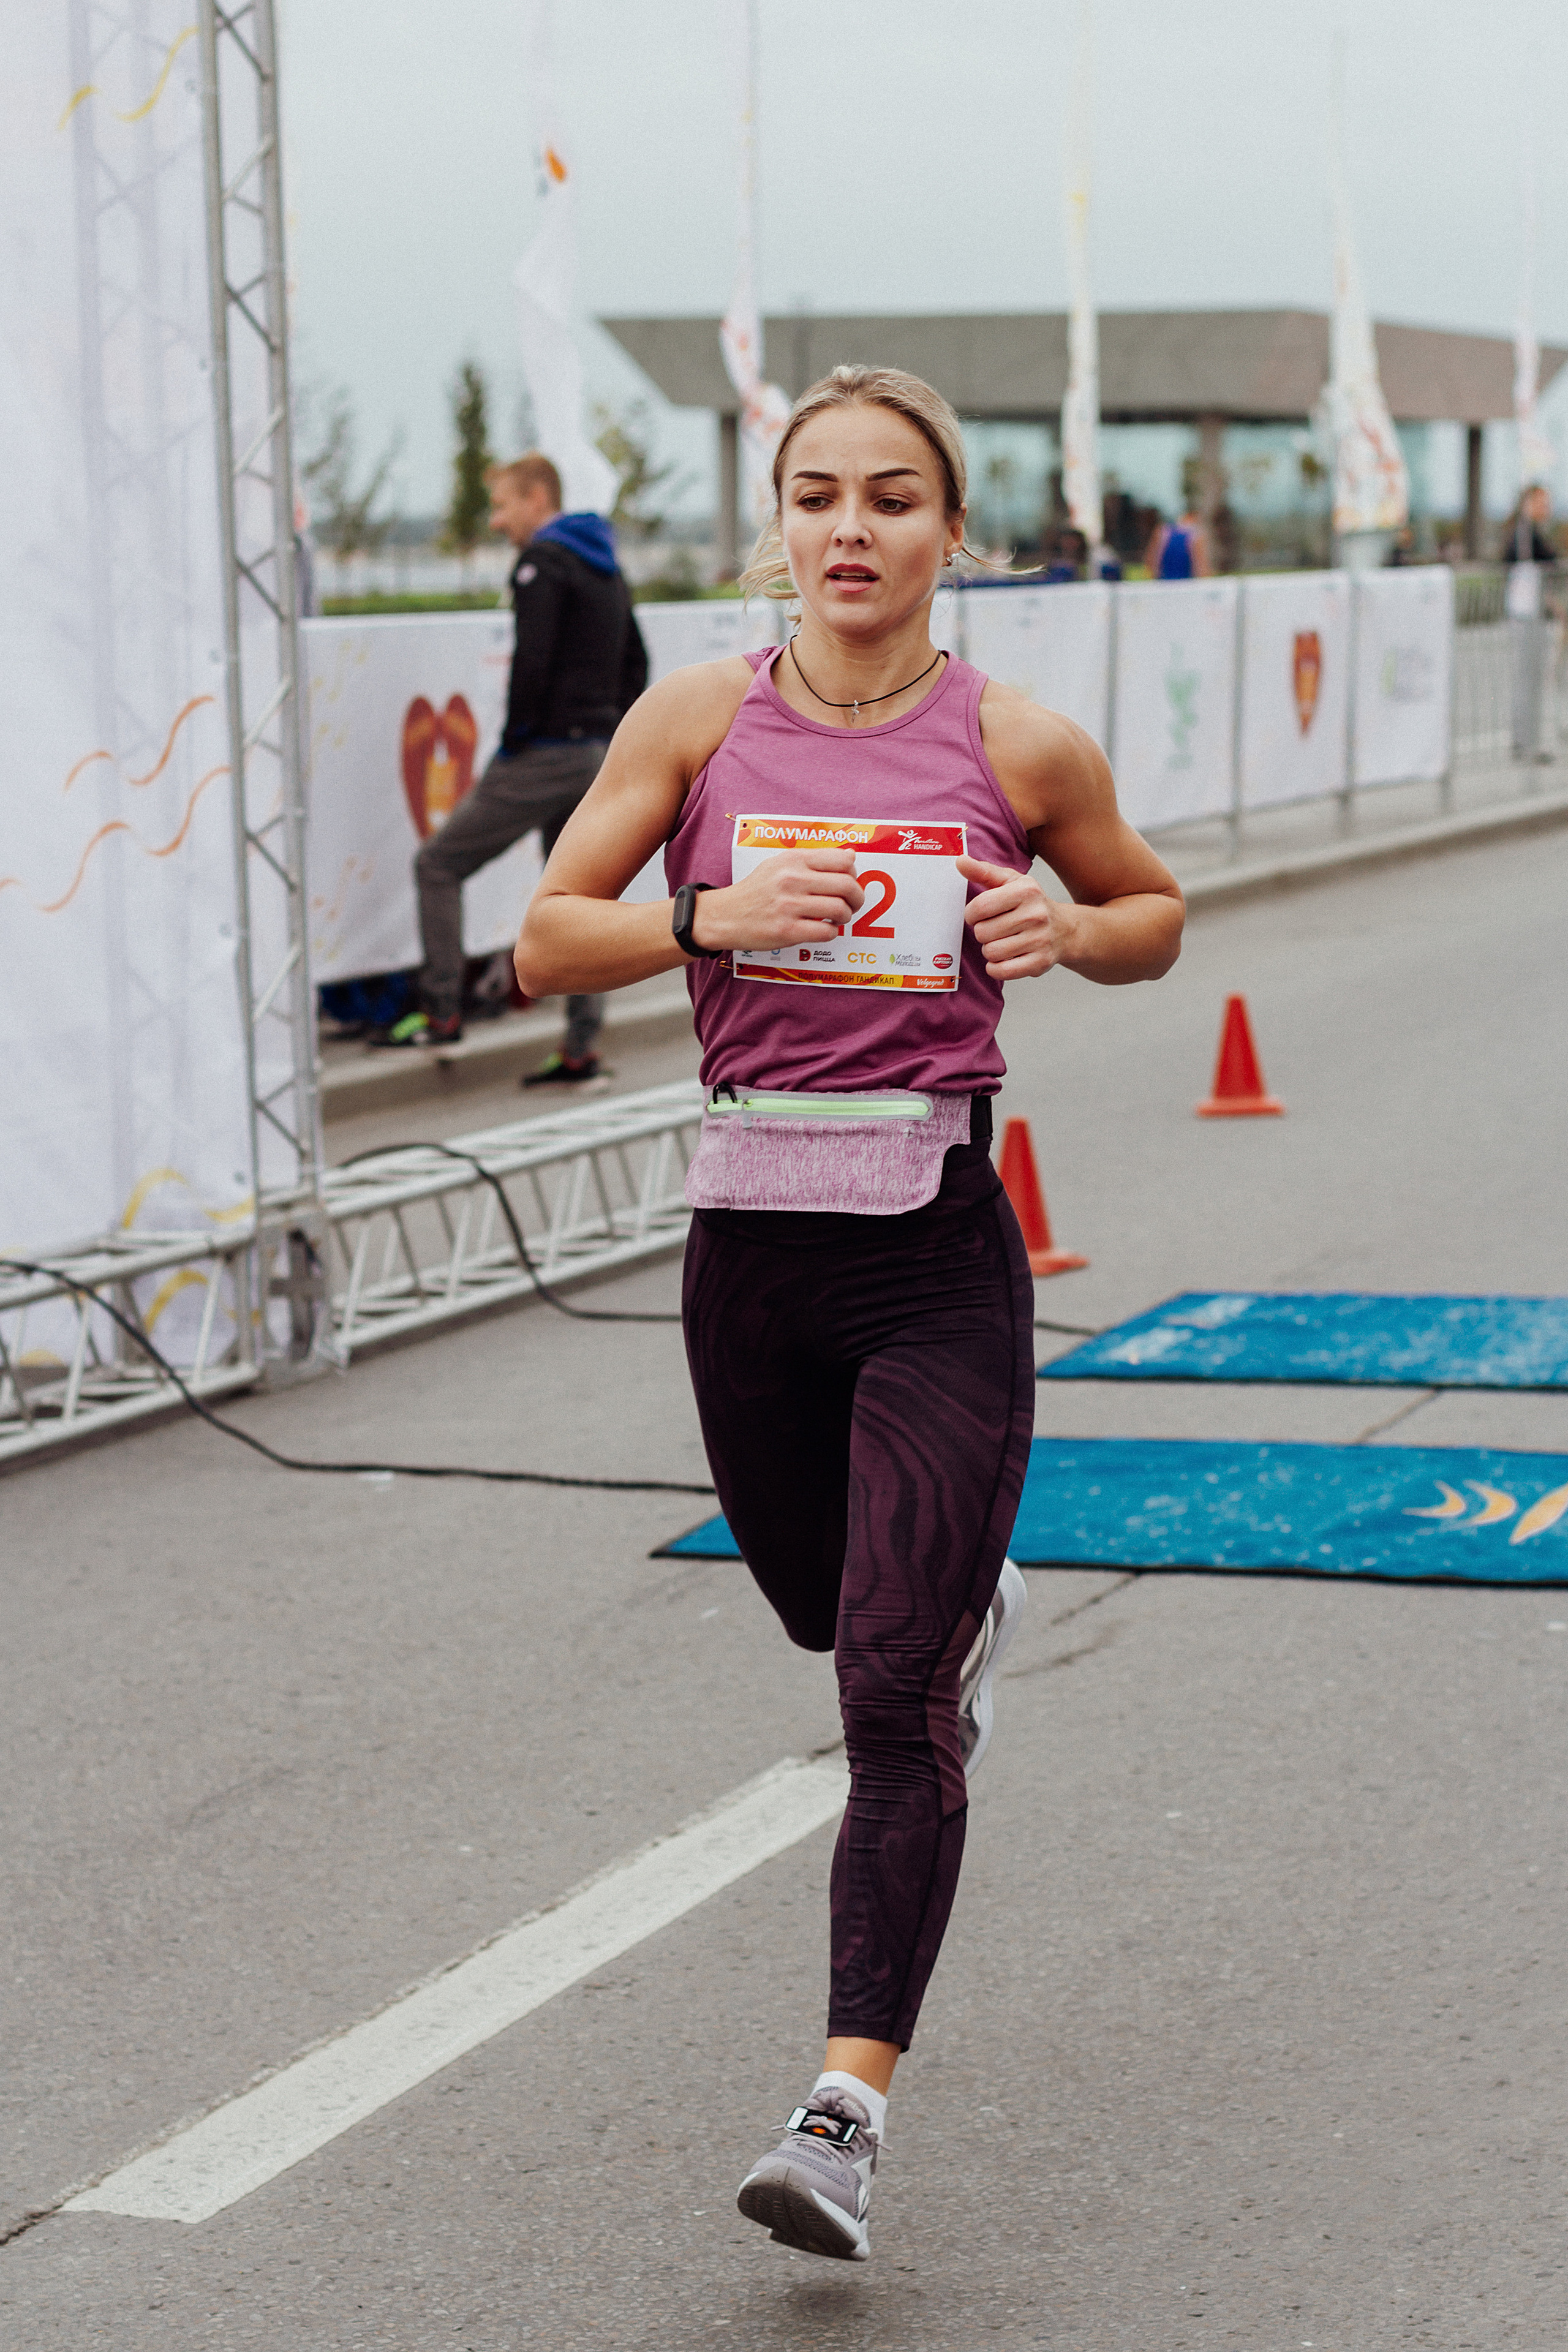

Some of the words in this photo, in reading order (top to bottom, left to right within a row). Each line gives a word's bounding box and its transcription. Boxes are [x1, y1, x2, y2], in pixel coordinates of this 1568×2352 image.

[755, 826, 868, 843] ПОЛУМАРАФОН
[837, 870, 896, 938] 2
[798, 973, 854, 982] ПОЛУМАРАФОН
[857, 975, 894, 984] ГАНДИКАП
